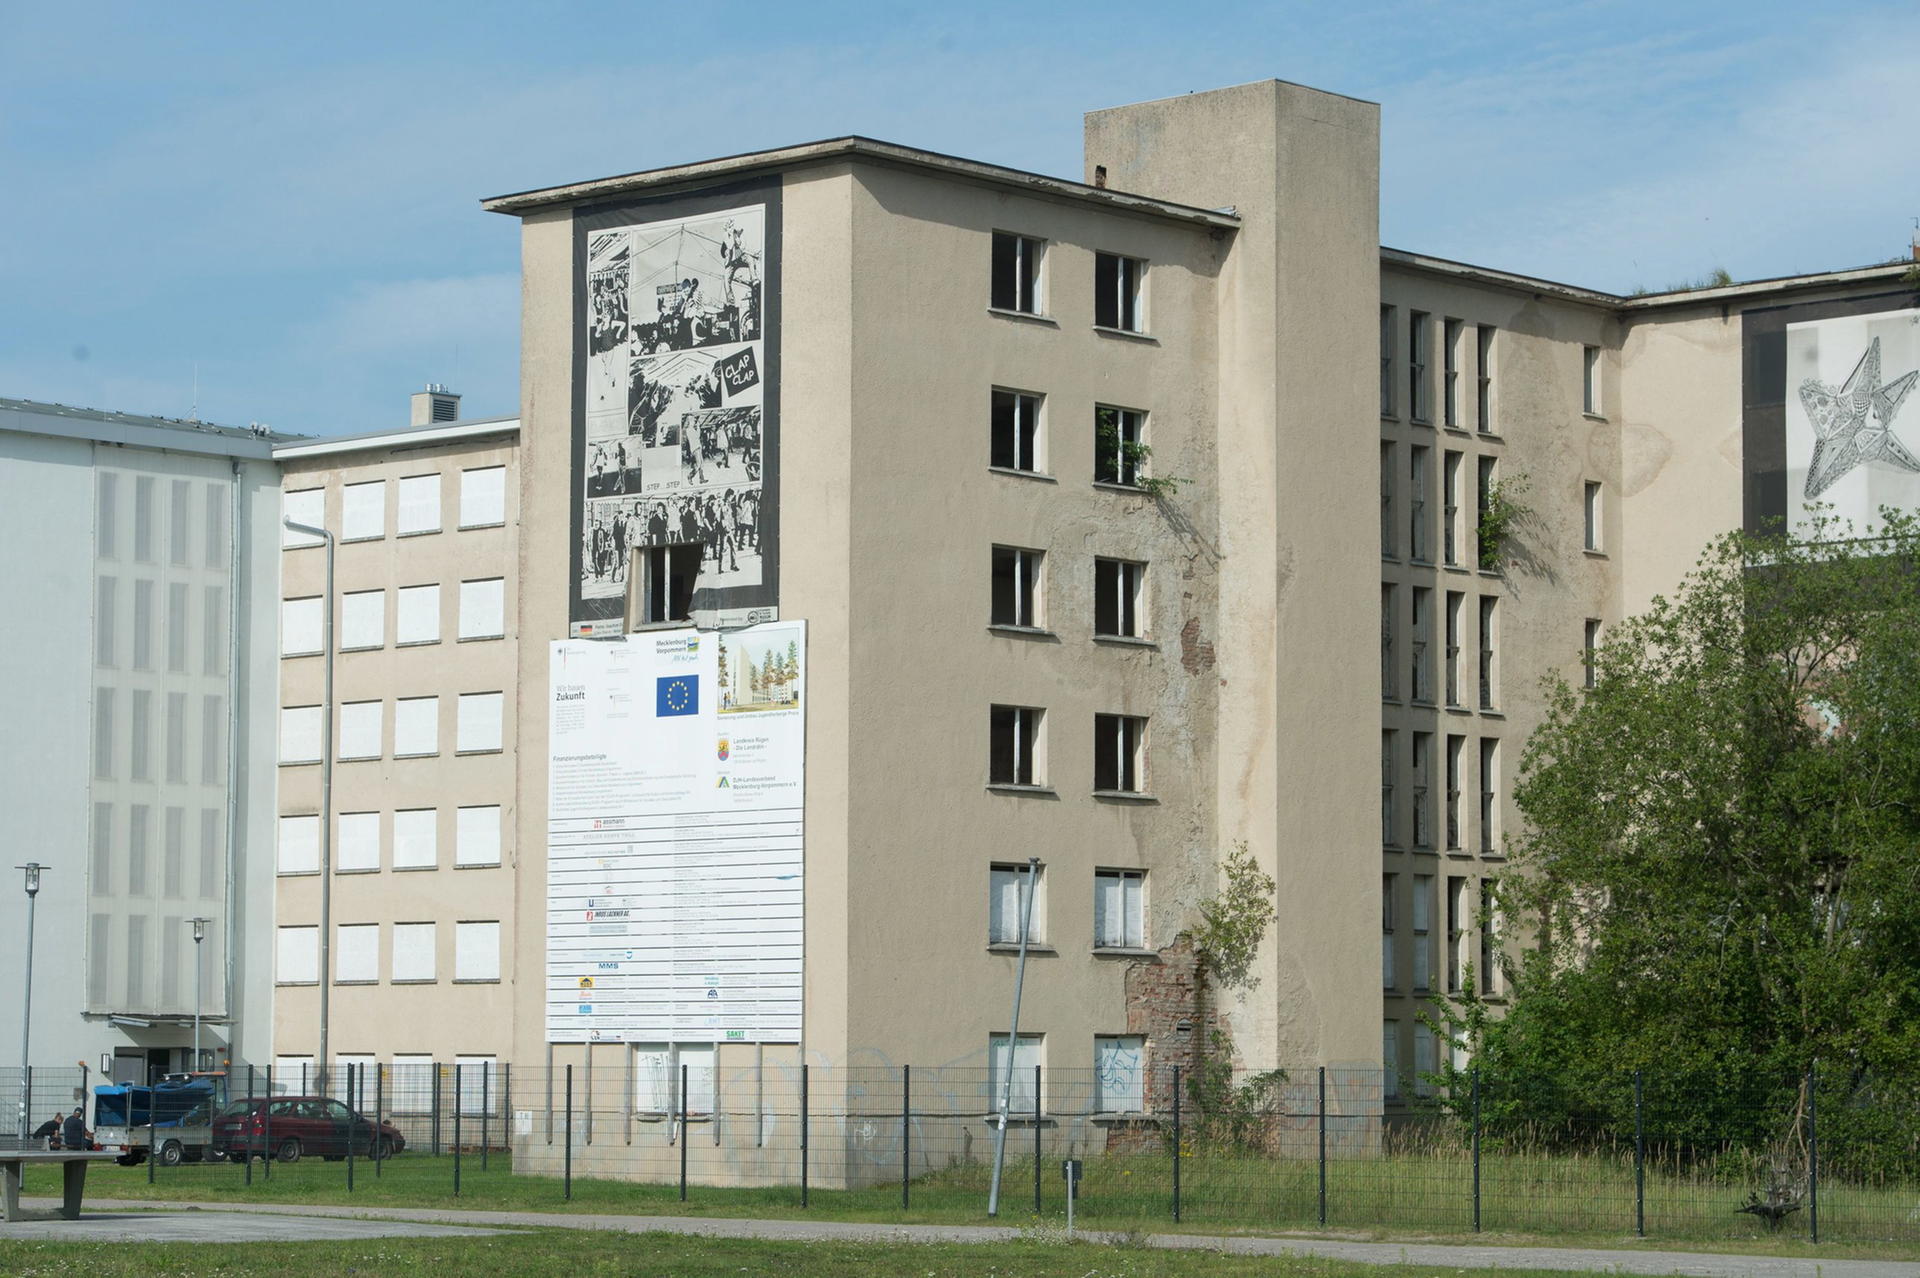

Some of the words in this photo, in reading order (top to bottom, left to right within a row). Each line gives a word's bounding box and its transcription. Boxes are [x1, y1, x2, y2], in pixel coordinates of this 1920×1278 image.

[725, 354, 750, 378] CLAP
[732, 370, 754, 385] CLAP
[646, 483, 660, 491] STEP
[666, 480, 680, 488] STEP
[656, 639, 687, 647] Mecklenburg
[656, 647, 687, 655] Vorpommern
[556, 691, 585, 701] Zukunft
